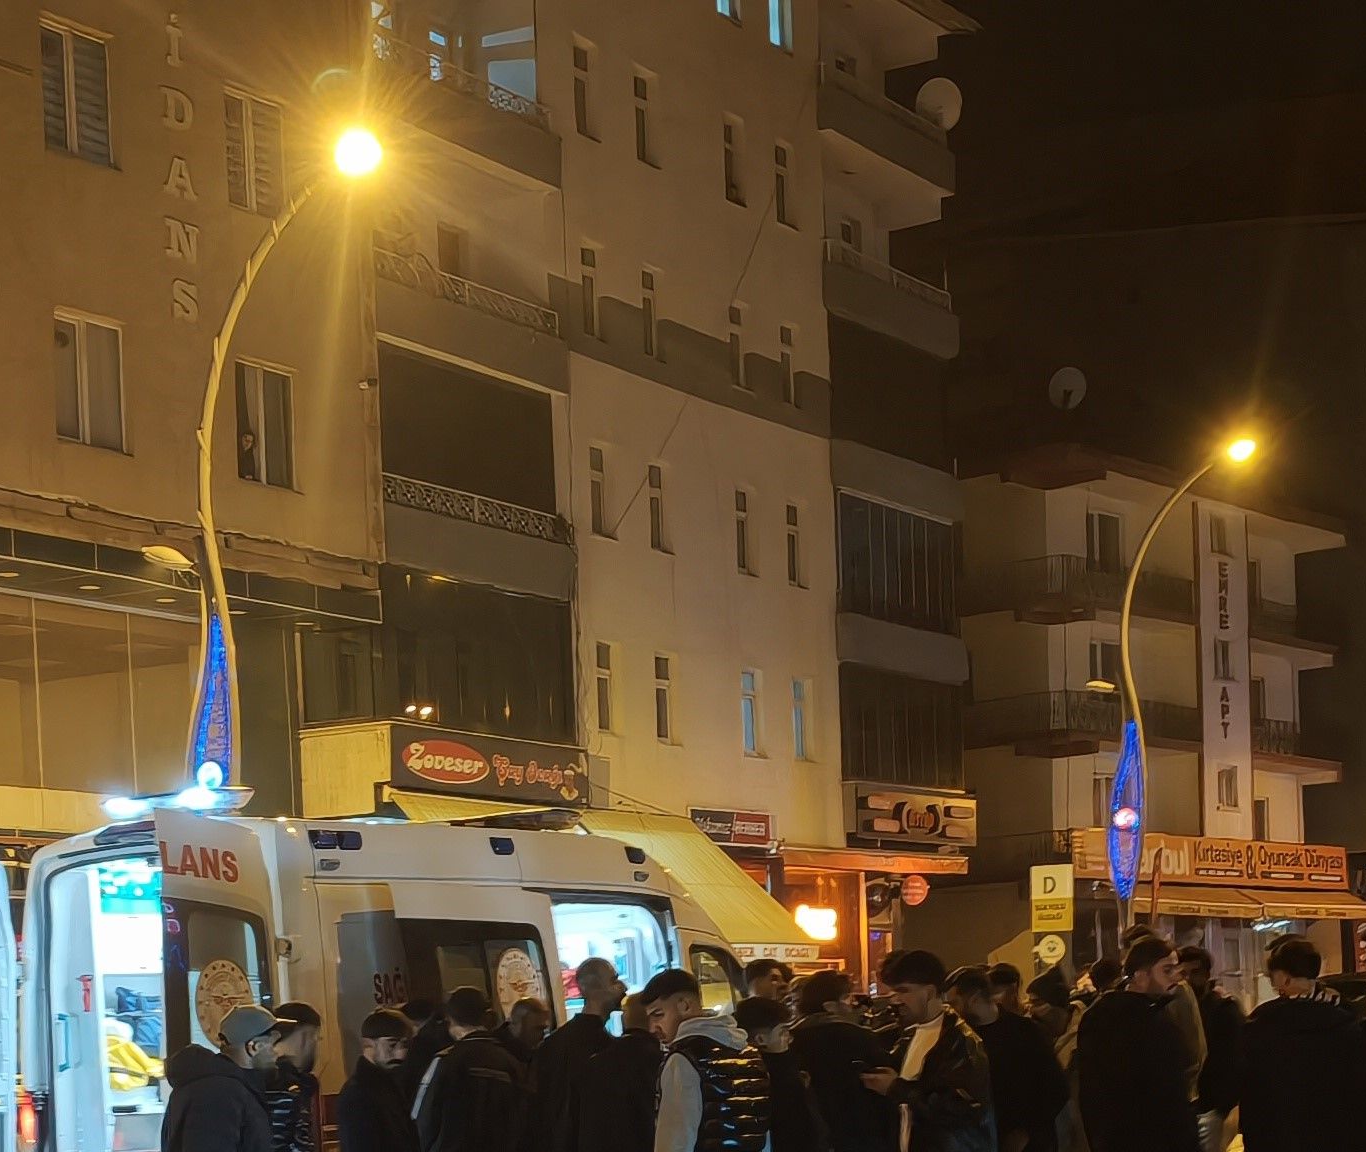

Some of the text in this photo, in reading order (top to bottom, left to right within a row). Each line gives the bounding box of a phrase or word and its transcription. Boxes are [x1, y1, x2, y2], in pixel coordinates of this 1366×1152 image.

[1220, 686, 1230, 740] APT
[158, 840, 240, 883] LANS
[1043, 876, 1057, 894] D
